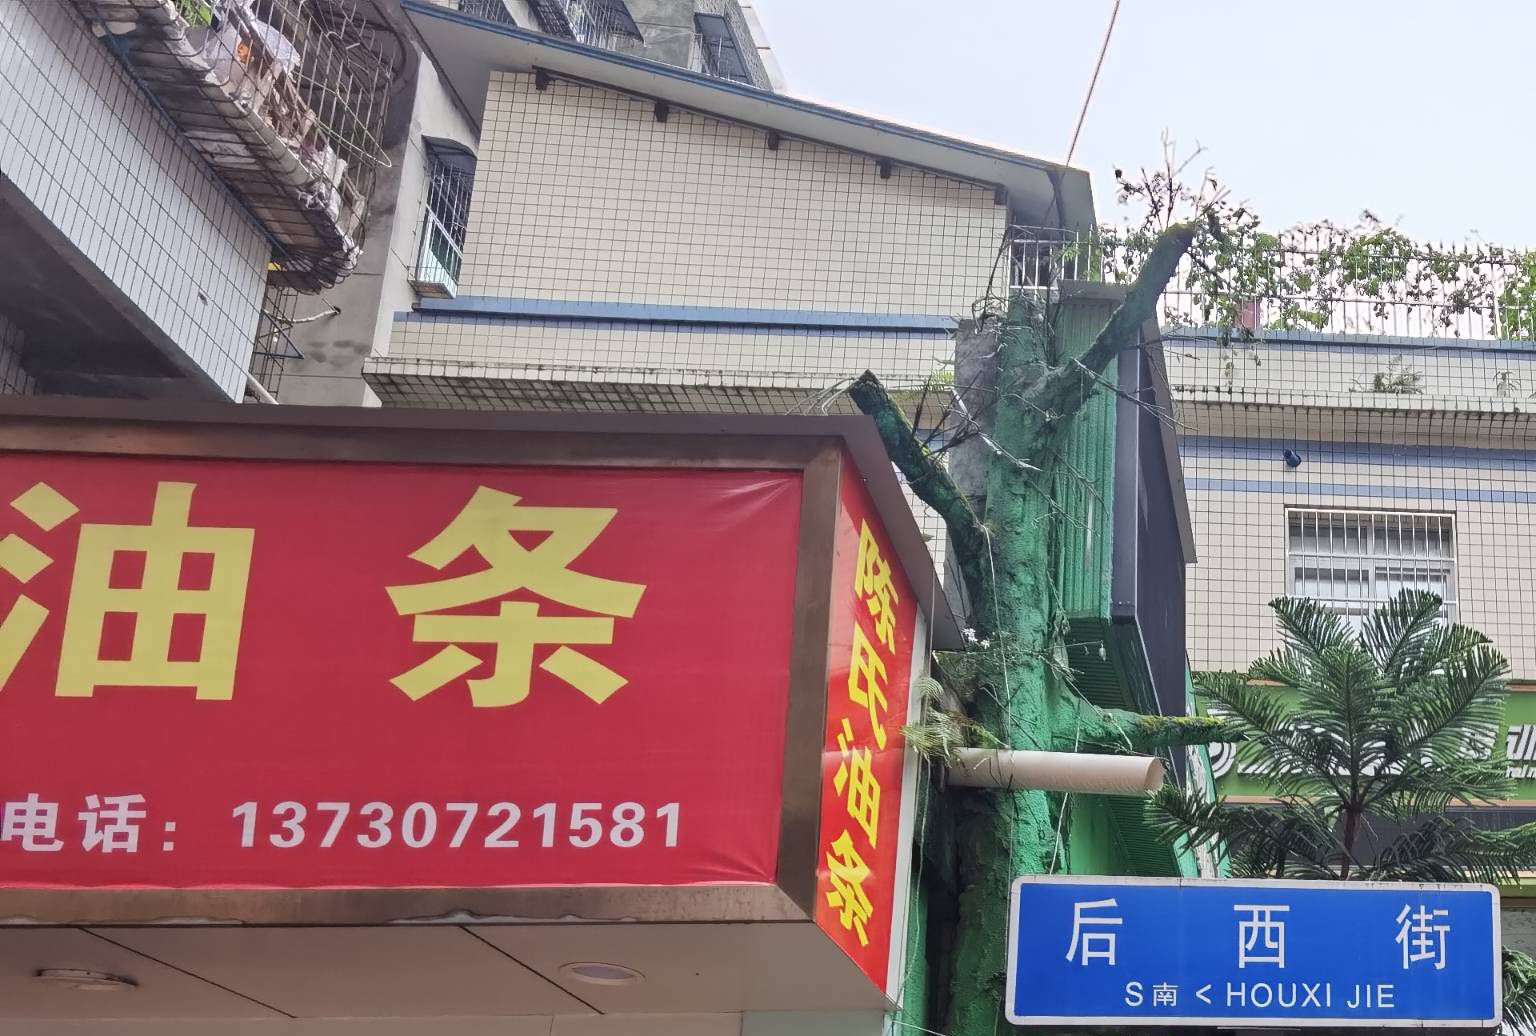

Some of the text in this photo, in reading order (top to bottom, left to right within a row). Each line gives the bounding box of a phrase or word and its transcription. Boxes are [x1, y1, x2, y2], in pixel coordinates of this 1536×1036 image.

[0, 481, 647, 708] 油条
[826, 517, 899, 947] 陈氏油条
[1226, 983, 1332, 1008] HOUXI
[1347, 984, 1395, 1009] JIE
